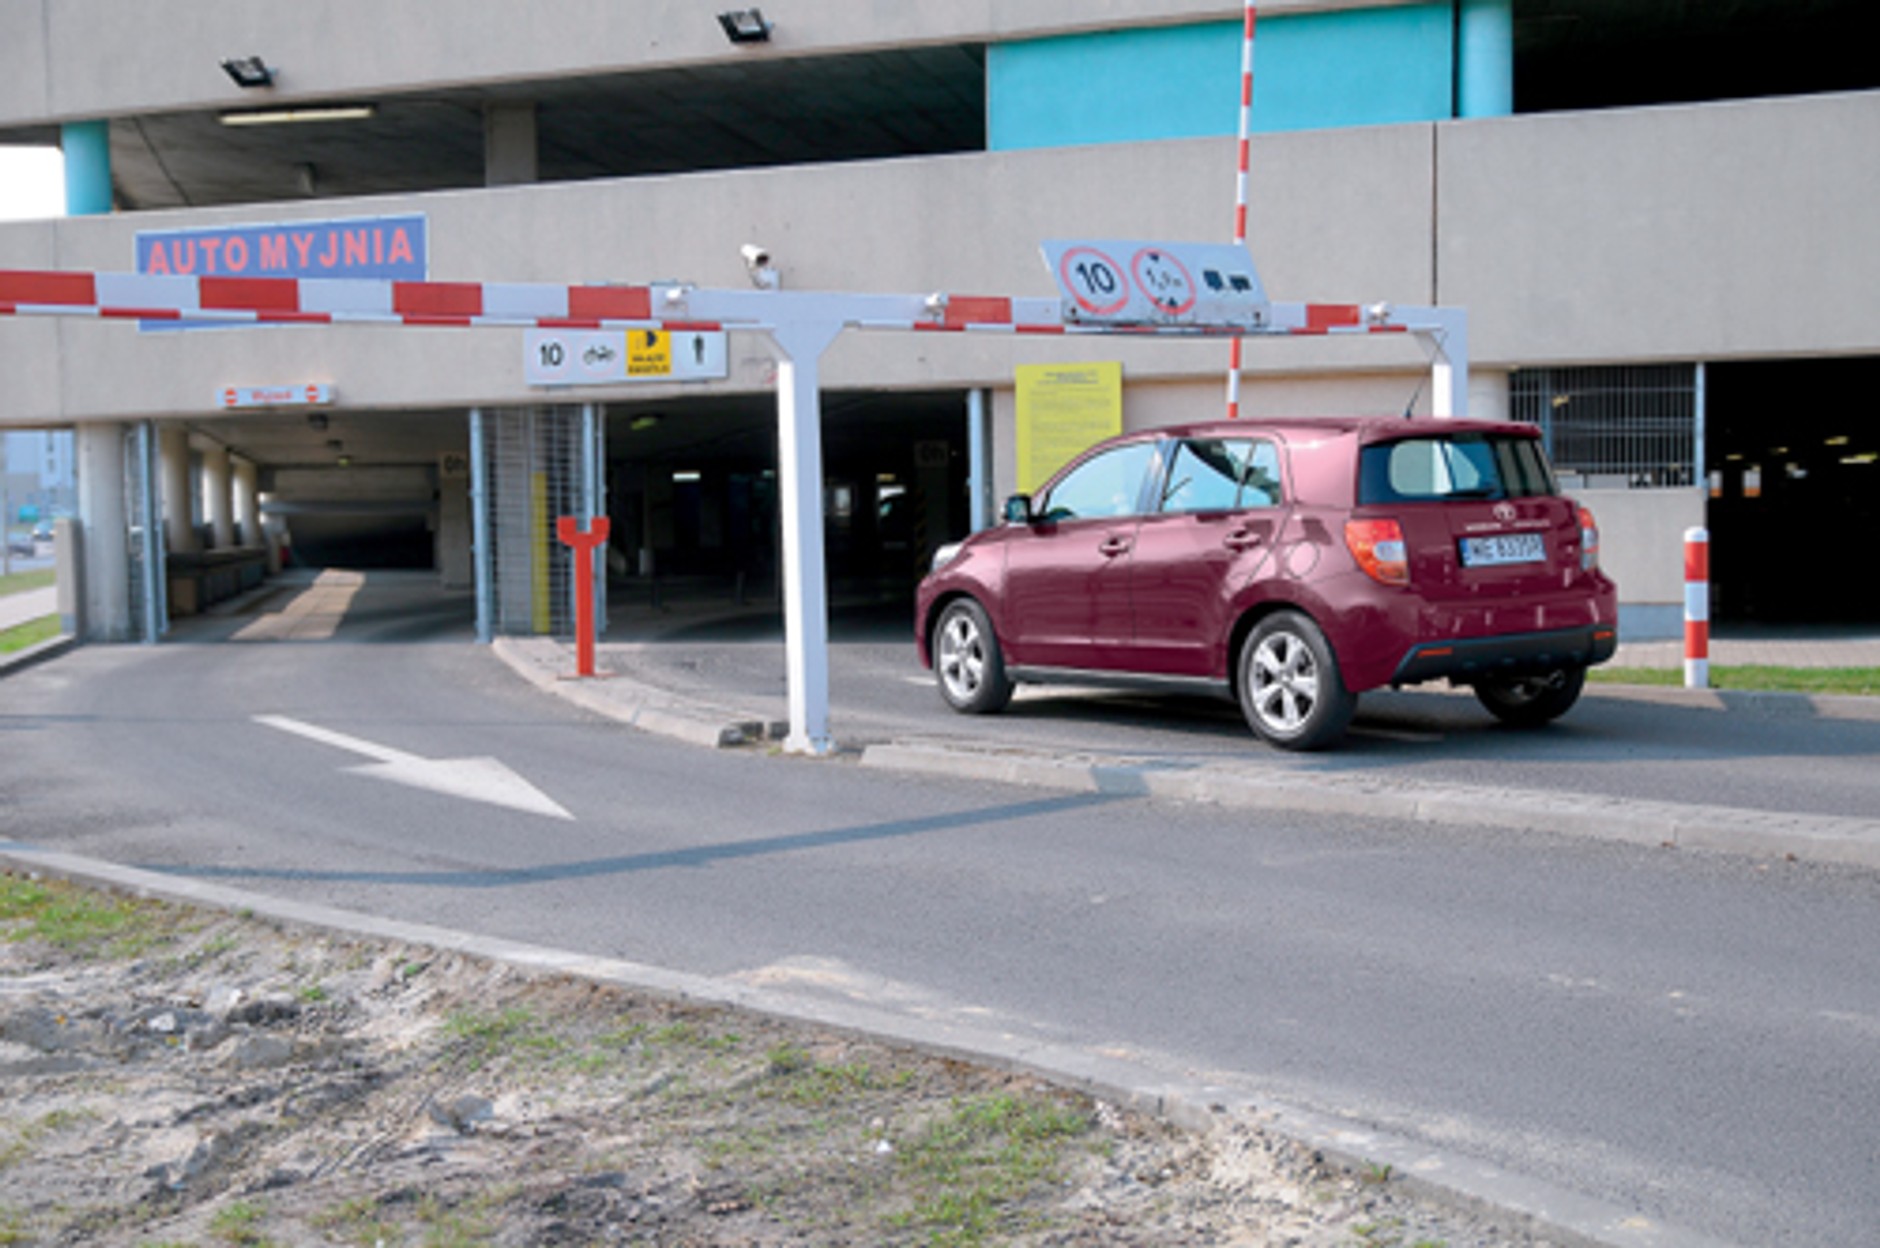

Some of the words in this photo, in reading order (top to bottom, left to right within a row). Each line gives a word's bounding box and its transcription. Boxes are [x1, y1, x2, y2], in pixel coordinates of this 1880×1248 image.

[147, 236, 249, 275] AUTO
[259, 227, 414, 270] MYJNIA
[1075, 262, 1116, 295] 10
[540, 342, 564, 366] 10
